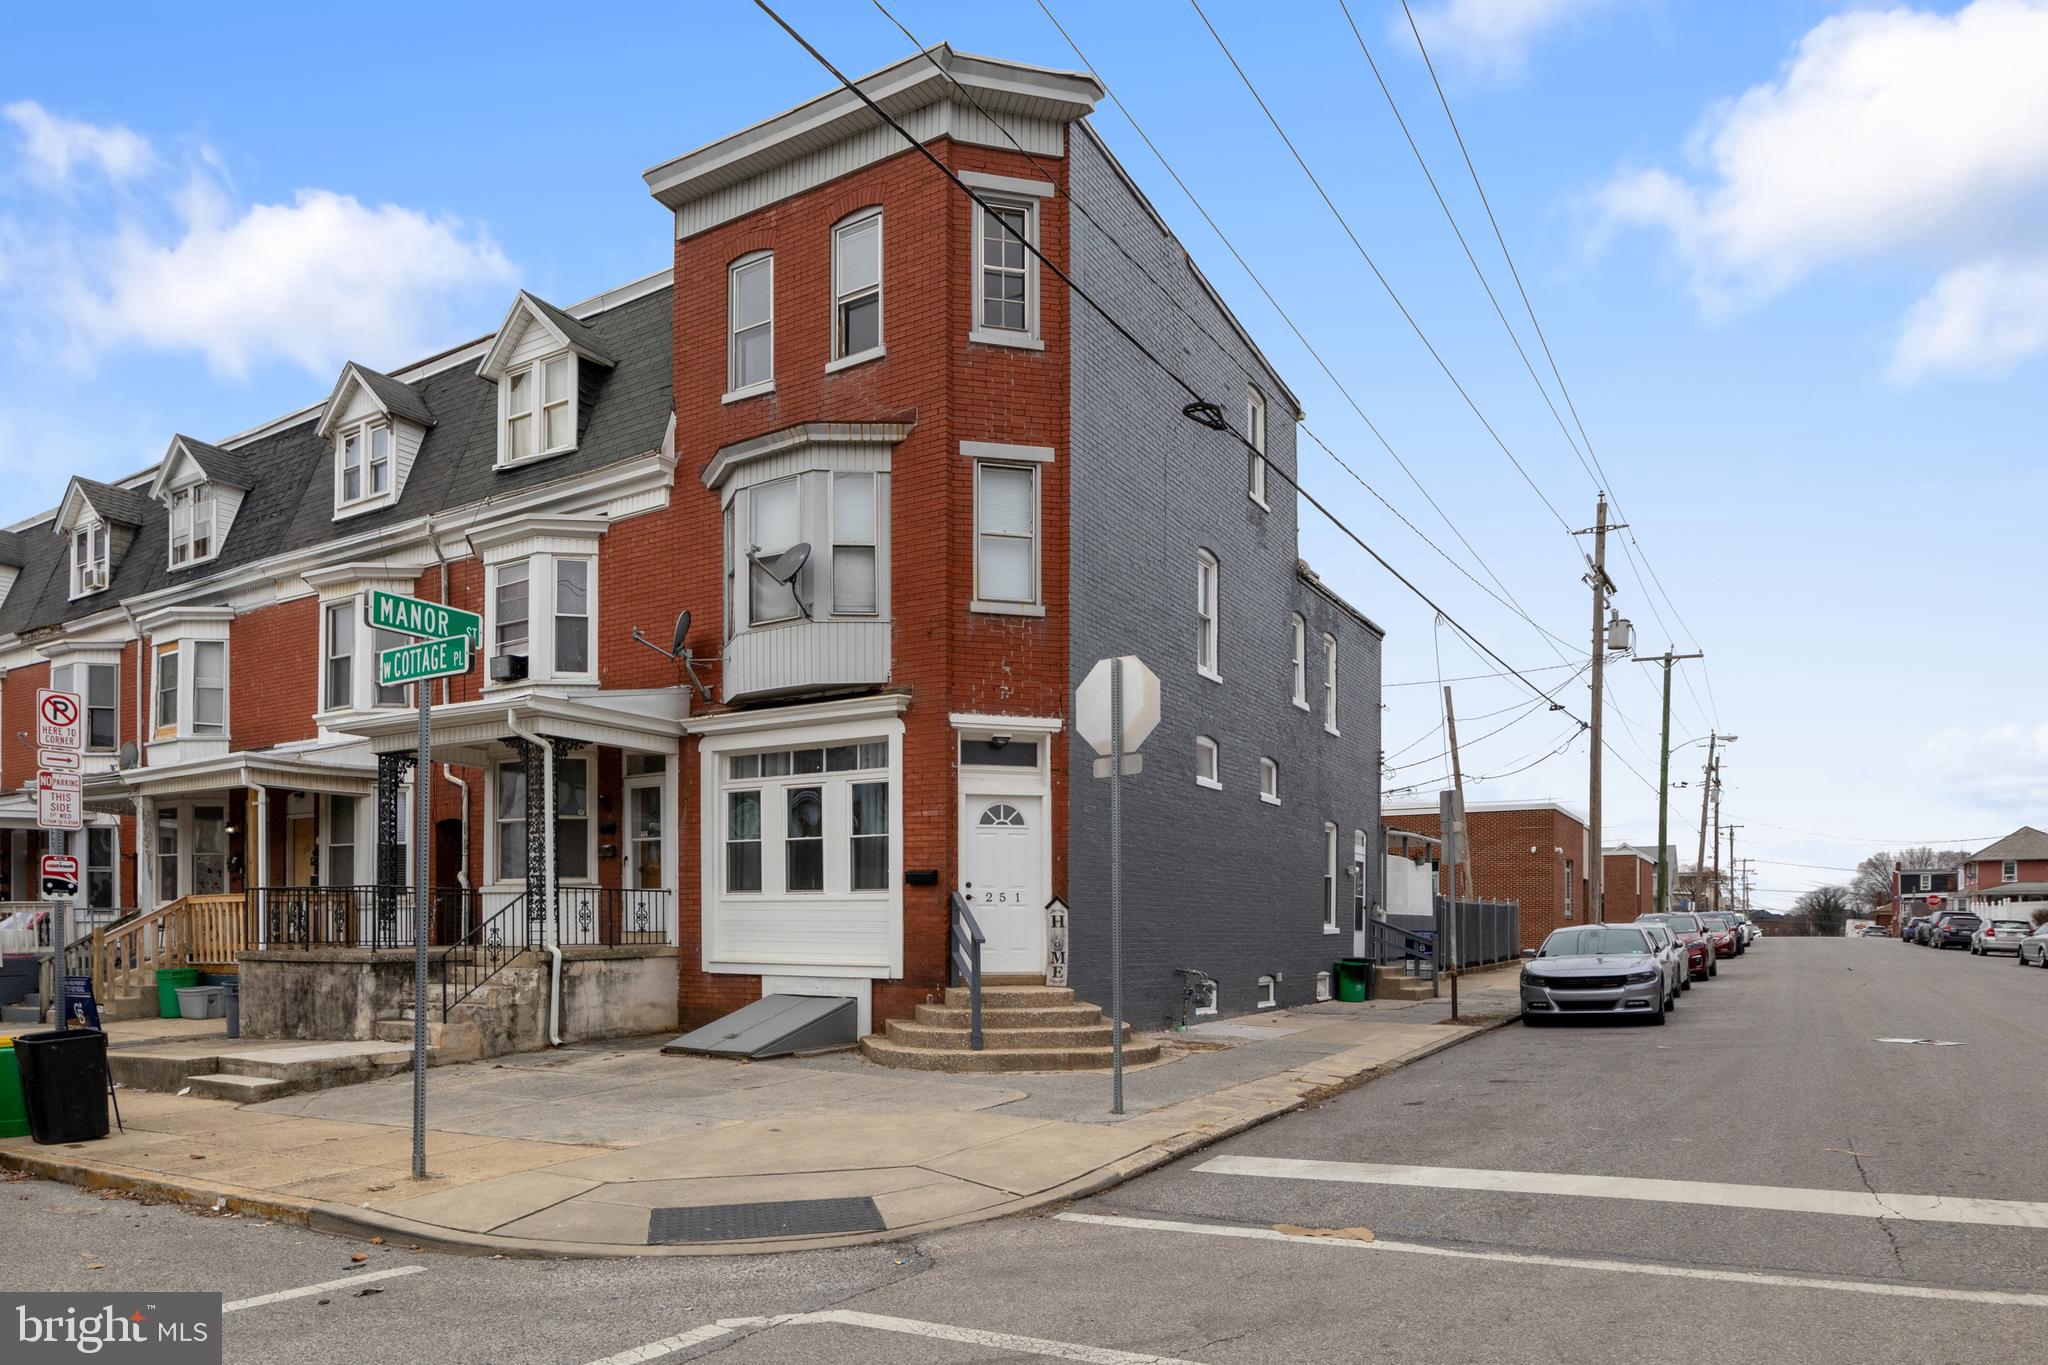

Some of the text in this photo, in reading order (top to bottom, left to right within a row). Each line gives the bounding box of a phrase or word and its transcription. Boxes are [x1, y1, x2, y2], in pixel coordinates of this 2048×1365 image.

[380, 596, 478, 638] MANOR ST
[384, 644, 463, 679] W COTTAGE PL
[42, 726, 76, 737] HERE TO
[46, 735, 74, 745] CORNER
[40, 775, 79, 788] NO PARKING
[51, 792, 71, 802] THIS
[50, 802, 71, 812] SIDE
